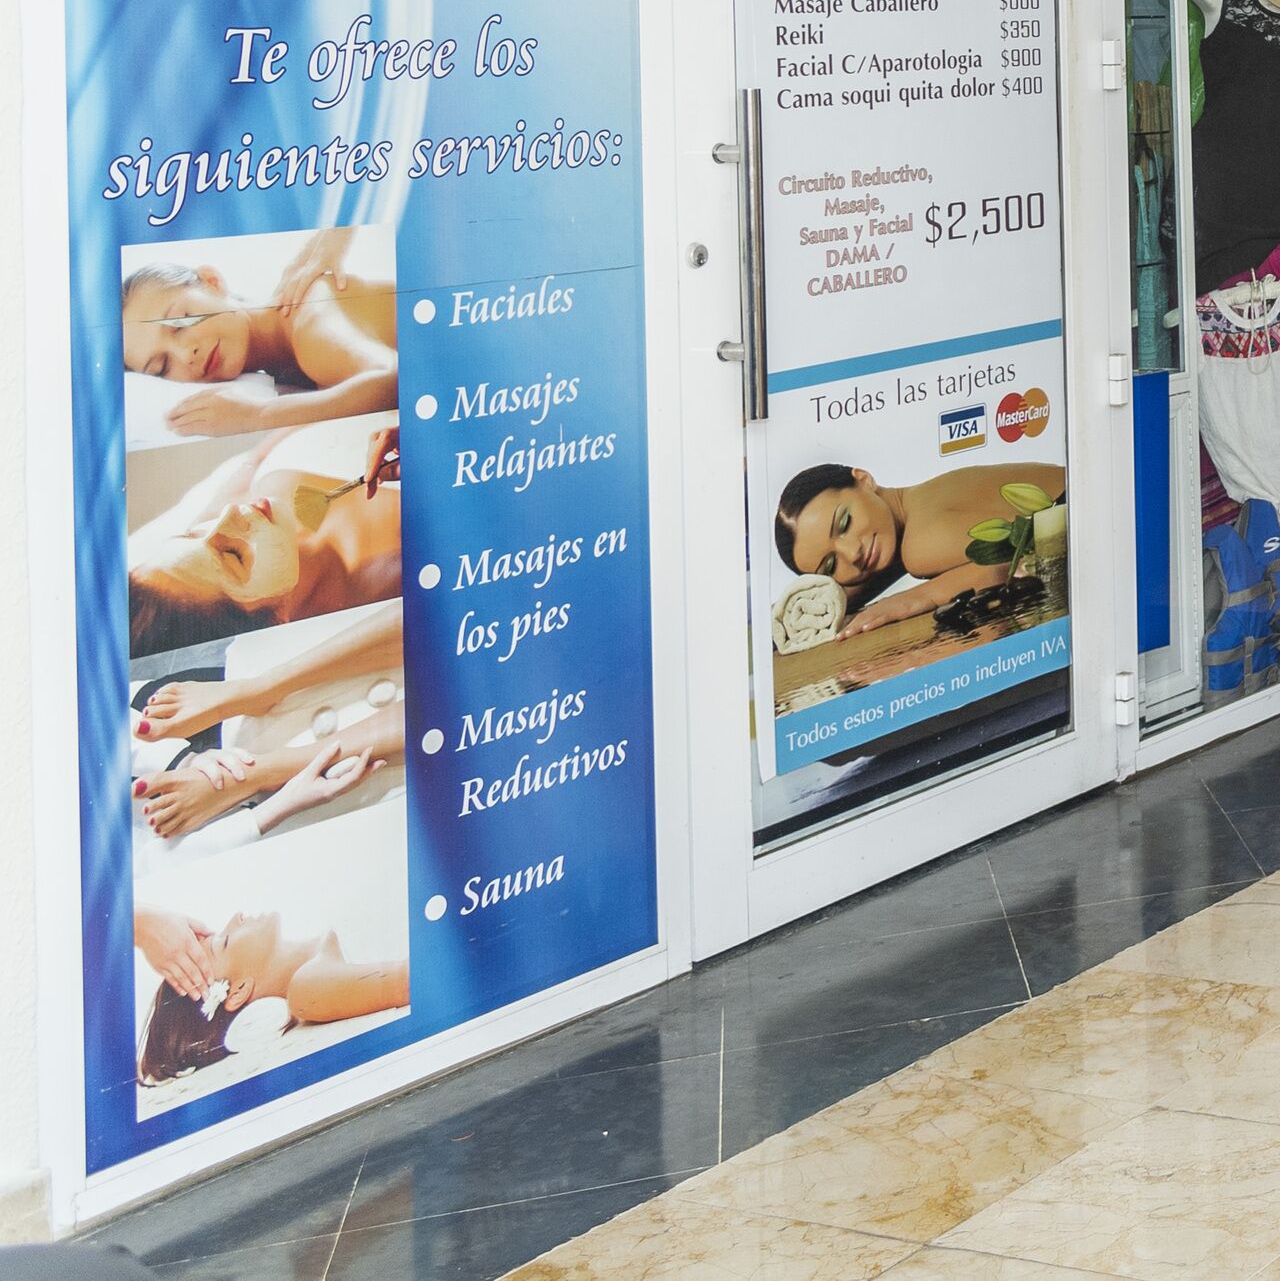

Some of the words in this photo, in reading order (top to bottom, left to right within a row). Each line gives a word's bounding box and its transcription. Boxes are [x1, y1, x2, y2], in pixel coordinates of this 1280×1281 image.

[775, 23, 825, 46] Reiki
[1000, 19, 1042, 41] $350
[224, 26, 289, 84] Te
[308, 14, 457, 110] ofrece
[473, 14, 538, 78] los
[776, 53, 834, 78] Facial
[841, 48, 983, 80] C/Aparotologia
[1000, 47, 1043, 68] $900
[776, 88, 834, 110] Cama
[841, 82, 892, 111] soqui
[899, 80, 944, 108] quita
[950, 77, 996, 99] dolor
[1001, 75, 1044, 98] $400
[102, 132, 393, 226] siguientes
[407, 118, 624, 179] servicios:
[778, 172, 846, 196] Circuito
[851, 164, 933, 189] Reductivo,
[799, 226, 849, 246] Sauna
[853, 224, 864, 244] y
[869, 212, 914, 237] Facial
[824, 193, 886, 217] Masaje,
[924, 192, 1045, 248] $2,500
[806, 264, 909, 297] CABALLERO
[825, 243, 881, 269] DAMA
[886, 242, 896, 261] /
[449, 275, 575, 329] Faciales
[449, 372, 580, 426] Masajes
[810, 387, 886, 424] Todas
[896, 377, 928, 406] las
[936, 362, 1017, 398] tarjetas
[996, 402, 1050, 429] MasterCard
[947, 419, 979, 440] VISA
[452, 429, 617, 492] Relajantes
[452, 534, 584, 590] Masajes
[593, 527, 628, 558] en
[456, 611, 499, 656] los
[498, 601, 571, 662] pies
[455, 688, 587, 752] Masajes
[785, 723, 838, 752] Todos
[843, 704, 885, 731] estos
[889, 683, 946, 719] precios
[950, 674, 970, 692] no
[975, 648, 1037, 684] incluyen
[1040, 634, 1067, 659] IVA
[458, 739, 628, 818] Reductivos
[460, 852, 565, 916] Sauna
